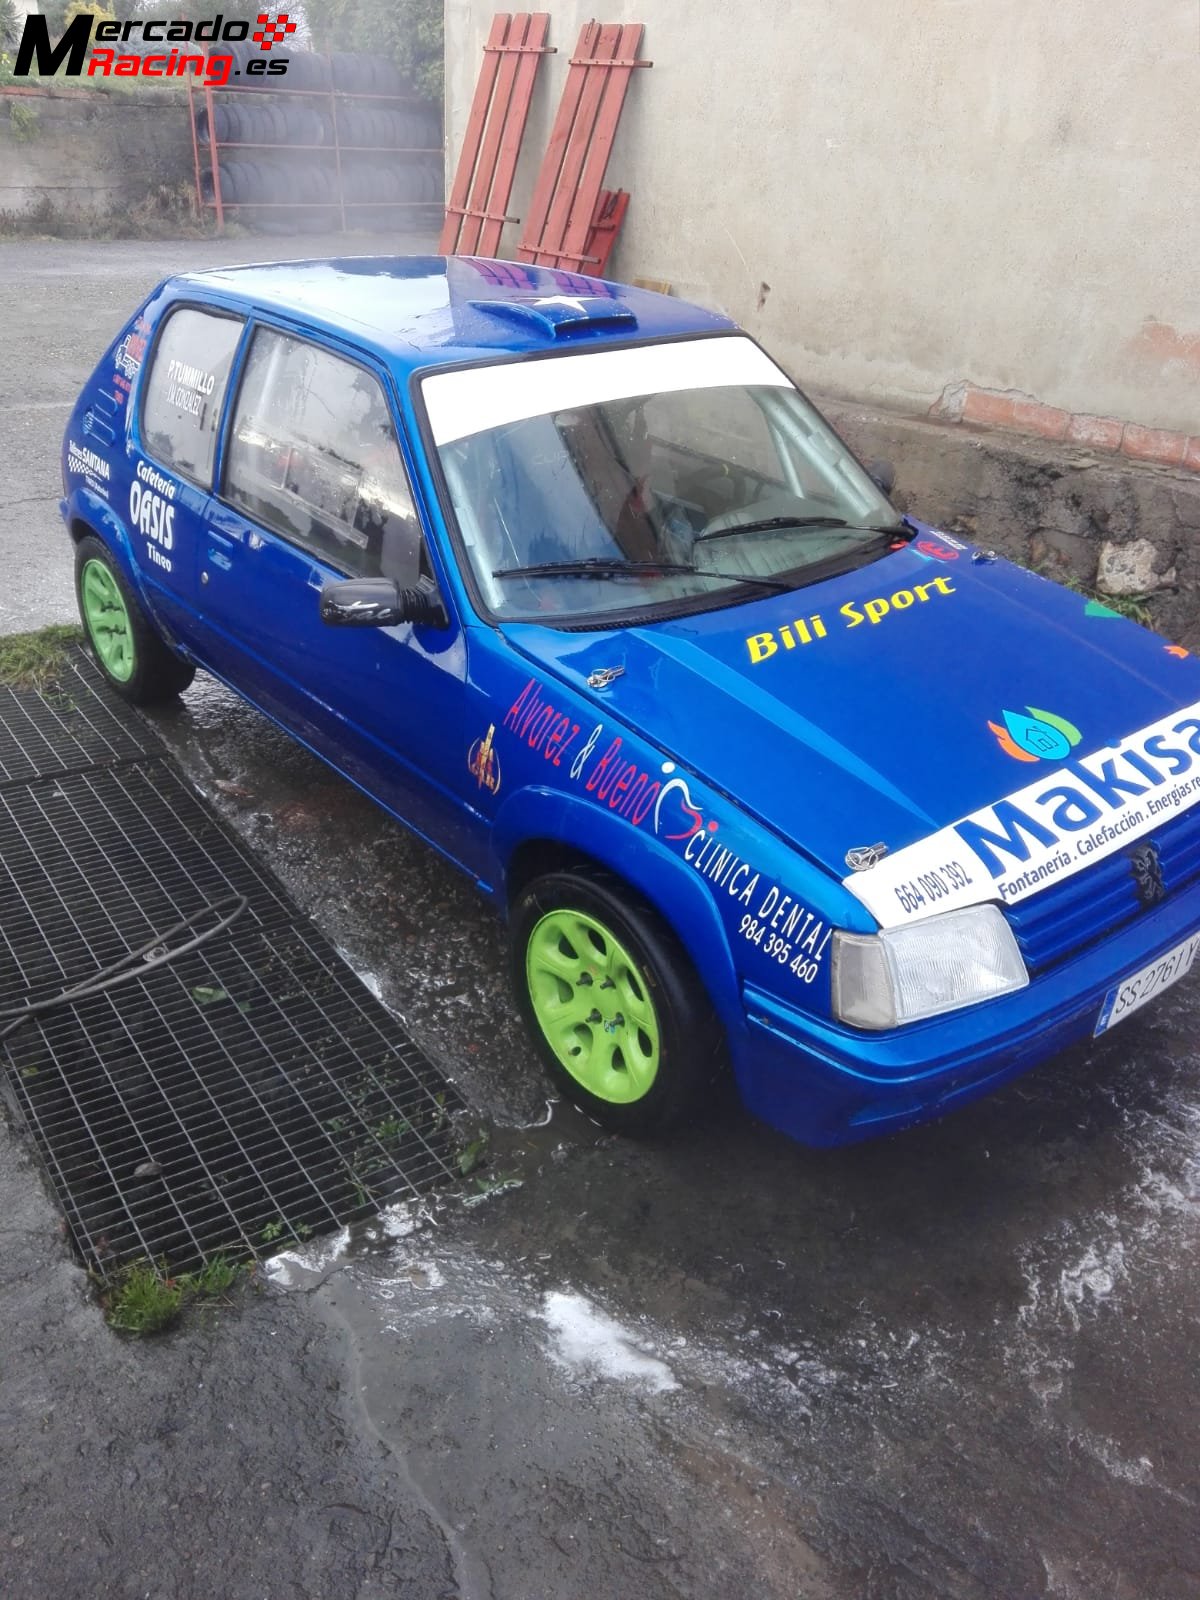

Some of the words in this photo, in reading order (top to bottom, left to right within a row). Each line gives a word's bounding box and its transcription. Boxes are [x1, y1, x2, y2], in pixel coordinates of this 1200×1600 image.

[82, 446, 110, 481] SANTANA
[129, 480, 175, 550] OASIS
[146, 541, 172, 572] Tineo
[746, 614, 828, 664] Bili
[839, 577, 957, 628] Sport
[503, 677, 580, 767] Alvarez
[569, 723, 603, 780] &
[586, 736, 662, 826] Bueno
[894, 879, 926, 914] 664
[920, 870, 949, 902] 090
[943, 861, 973, 890] 392
[997, 850, 1072, 900] Fontanería
[1076, 811, 1144, 856] Calefacción
[684, 829, 761, 907] CLINICA
[758, 886, 833, 961] DENTAL
[738, 913, 767, 946] 984
[763, 933, 792, 964] 395
[789, 953, 819, 984] 460
[1115, 979, 1141, 1014] SS
[1140, 949, 1184, 999] 2761
